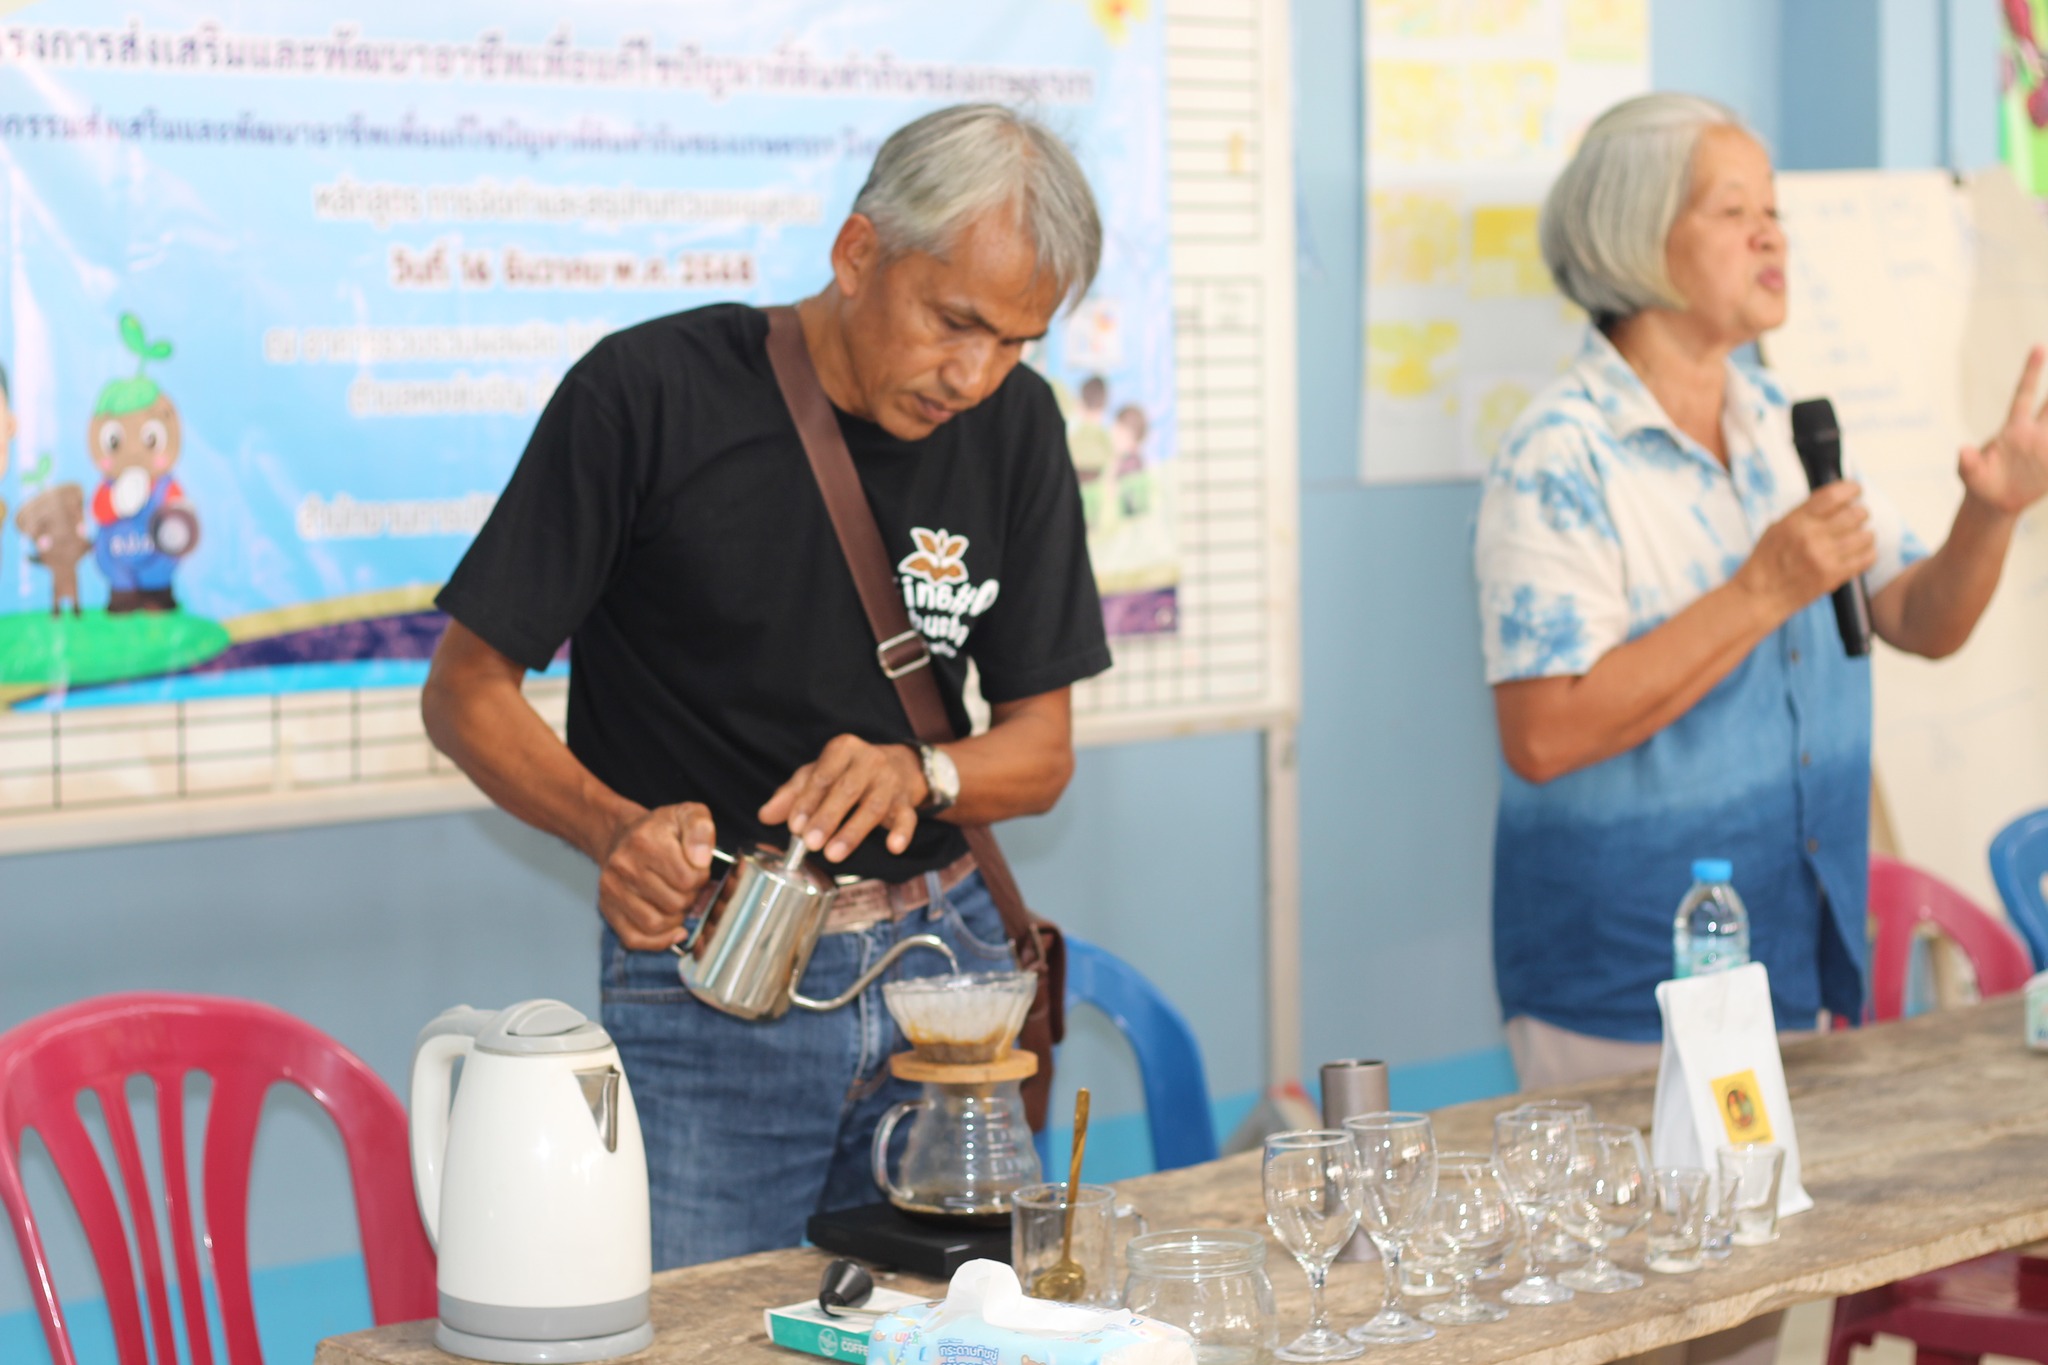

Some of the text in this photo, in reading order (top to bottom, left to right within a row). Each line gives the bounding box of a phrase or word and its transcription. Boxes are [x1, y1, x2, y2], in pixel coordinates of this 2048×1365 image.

[0, 19, 1091, 96] รงการส่งเสริมและพัฒนาอาชีพเพื่อแก้ไขปัญหาที่ดินทำกินของเกษตรกร
[394, 241, 446, 282] วันที่
[505, 249, 602, 283] ธันวาคม
